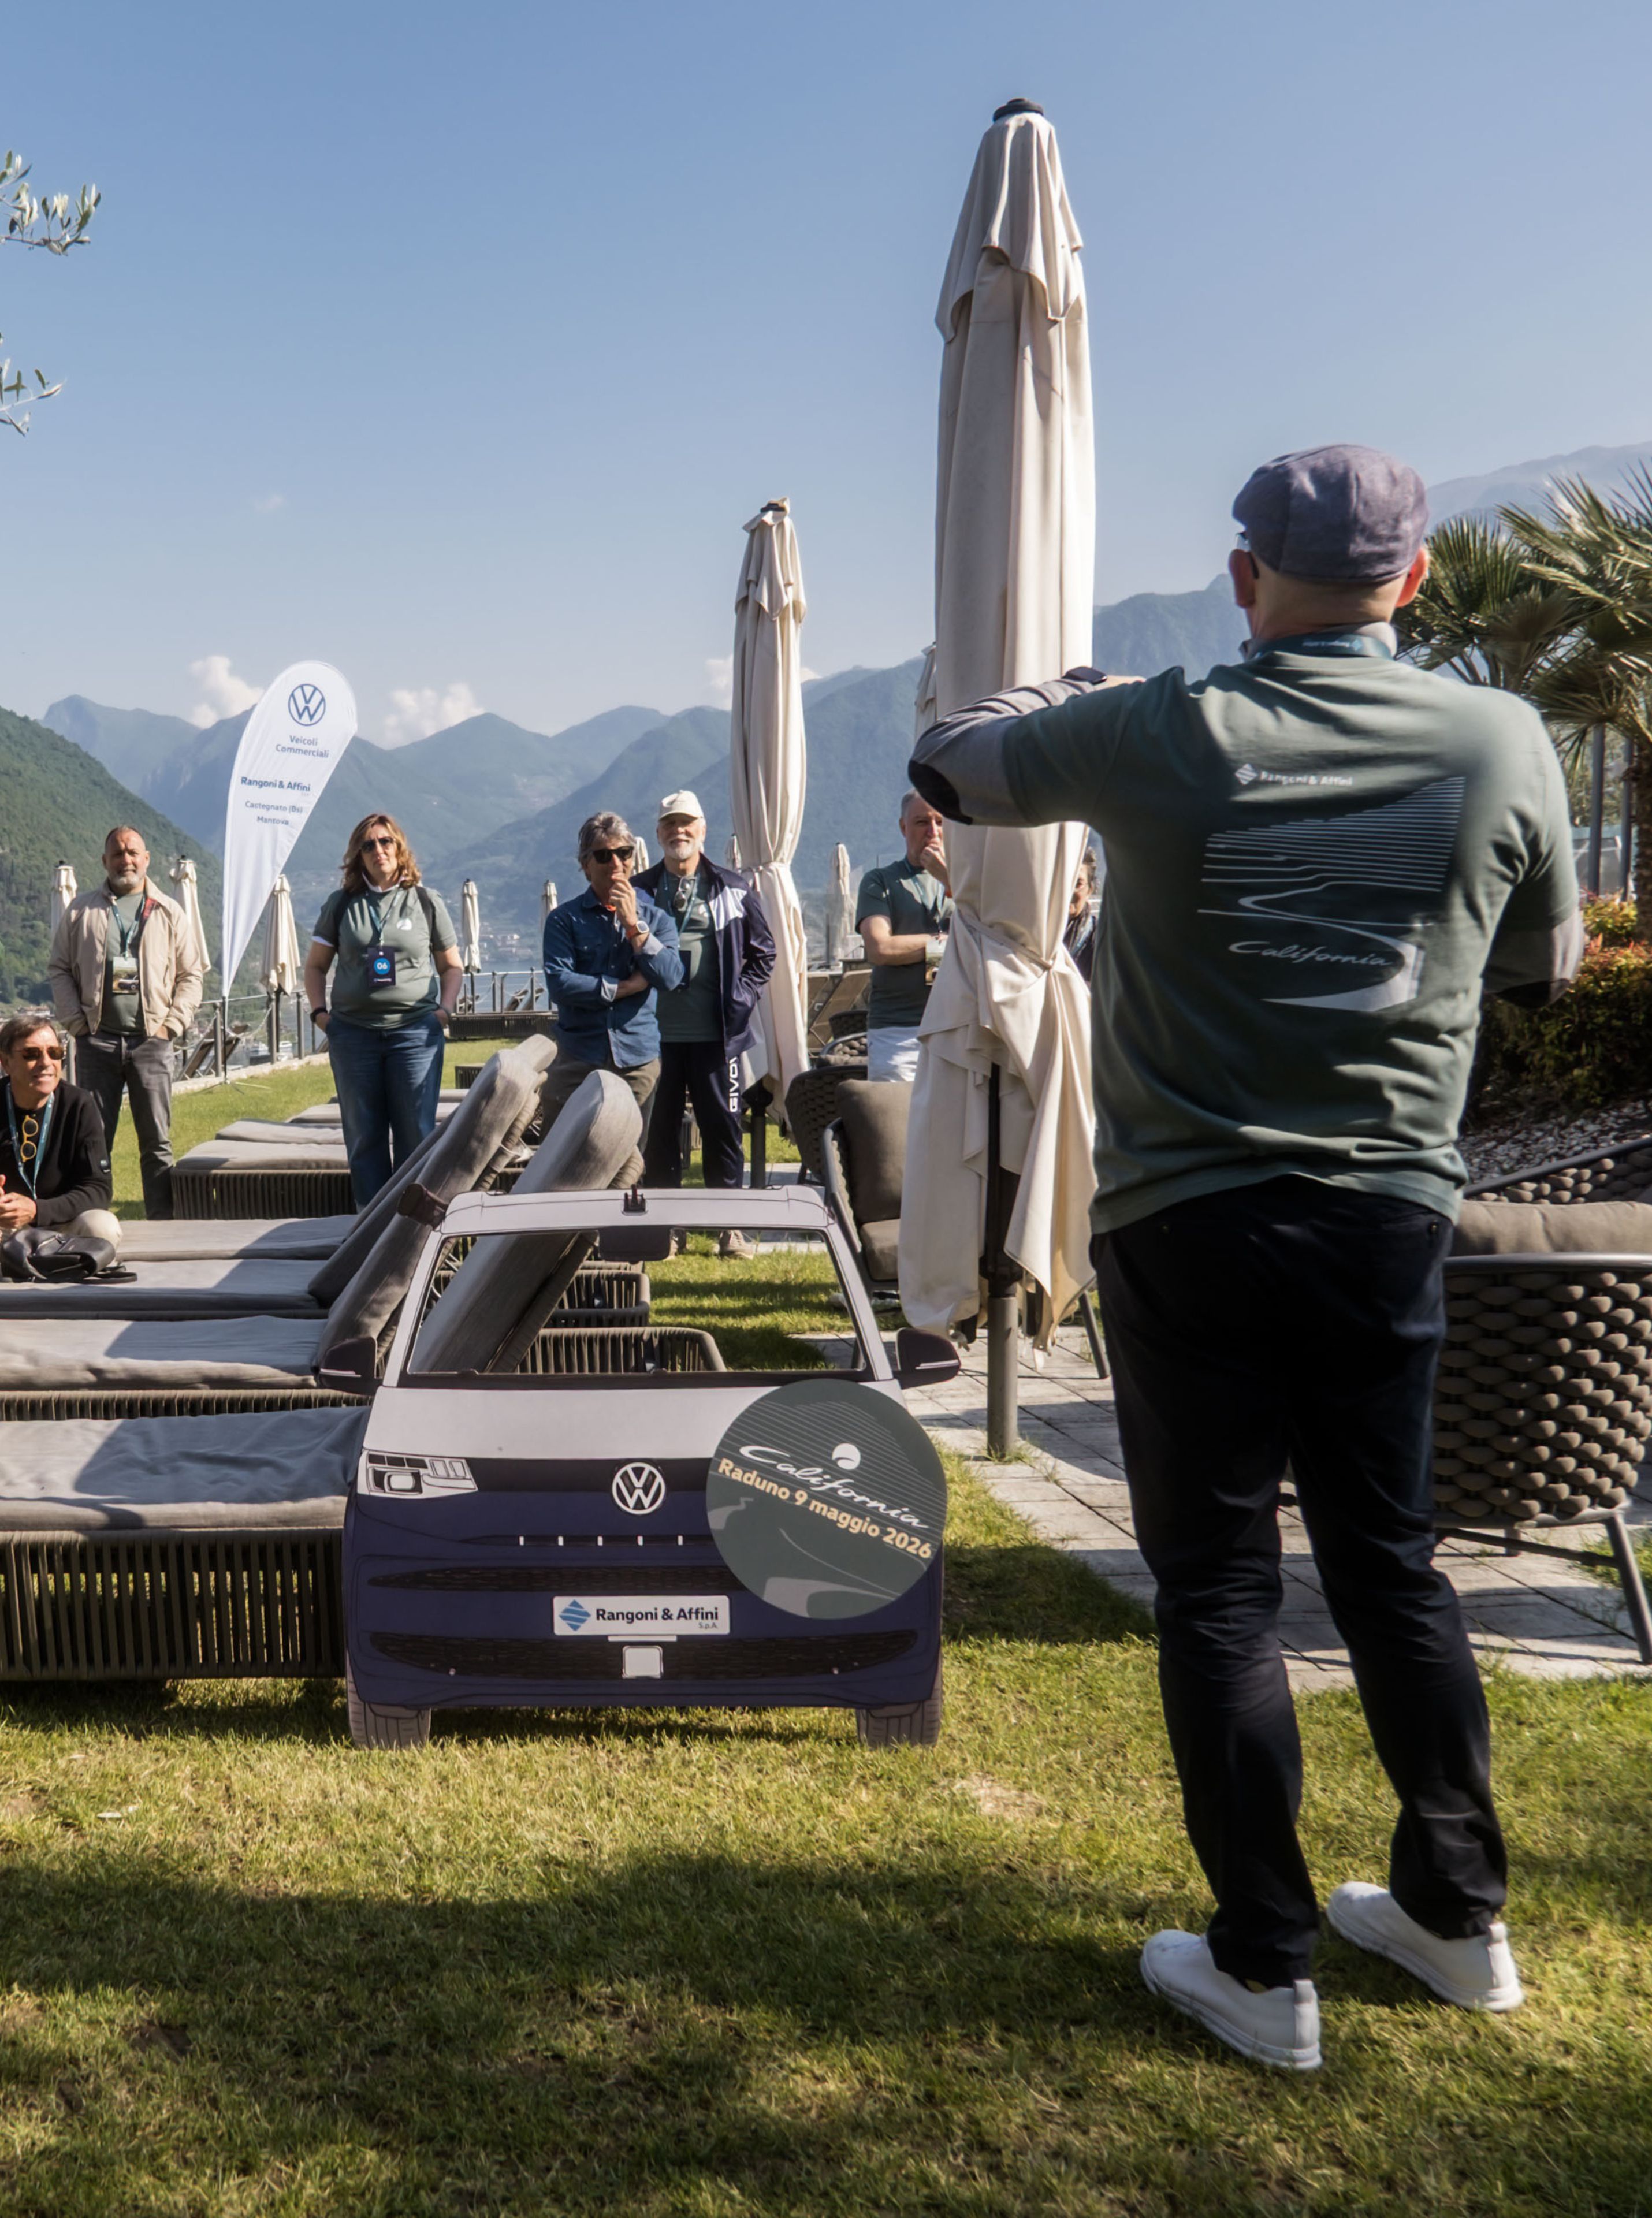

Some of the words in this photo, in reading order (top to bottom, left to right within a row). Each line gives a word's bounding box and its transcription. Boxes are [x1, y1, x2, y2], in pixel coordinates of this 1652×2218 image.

[289, 735, 318, 746] Veicoli
[276, 744, 330, 758] Commerciali
[241, 777, 277, 788] Rangoni
[278, 781, 284, 789] &
[287, 782, 310, 791] Affini
[257, 816, 289, 825] Mantova
[1229, 941, 1393, 966] California
[739, 1446, 929, 1528] California
[717, 1457, 790, 1500] Raduno
[795, 1489, 808, 1505] 9
[809, 1498, 880, 1538] maggio
[883, 1527, 932, 1559] 2026
[596, 1608, 657, 1624] Rangoni
[661, 1609, 672, 1621] &
[677, 1607, 718, 1620] Affini
